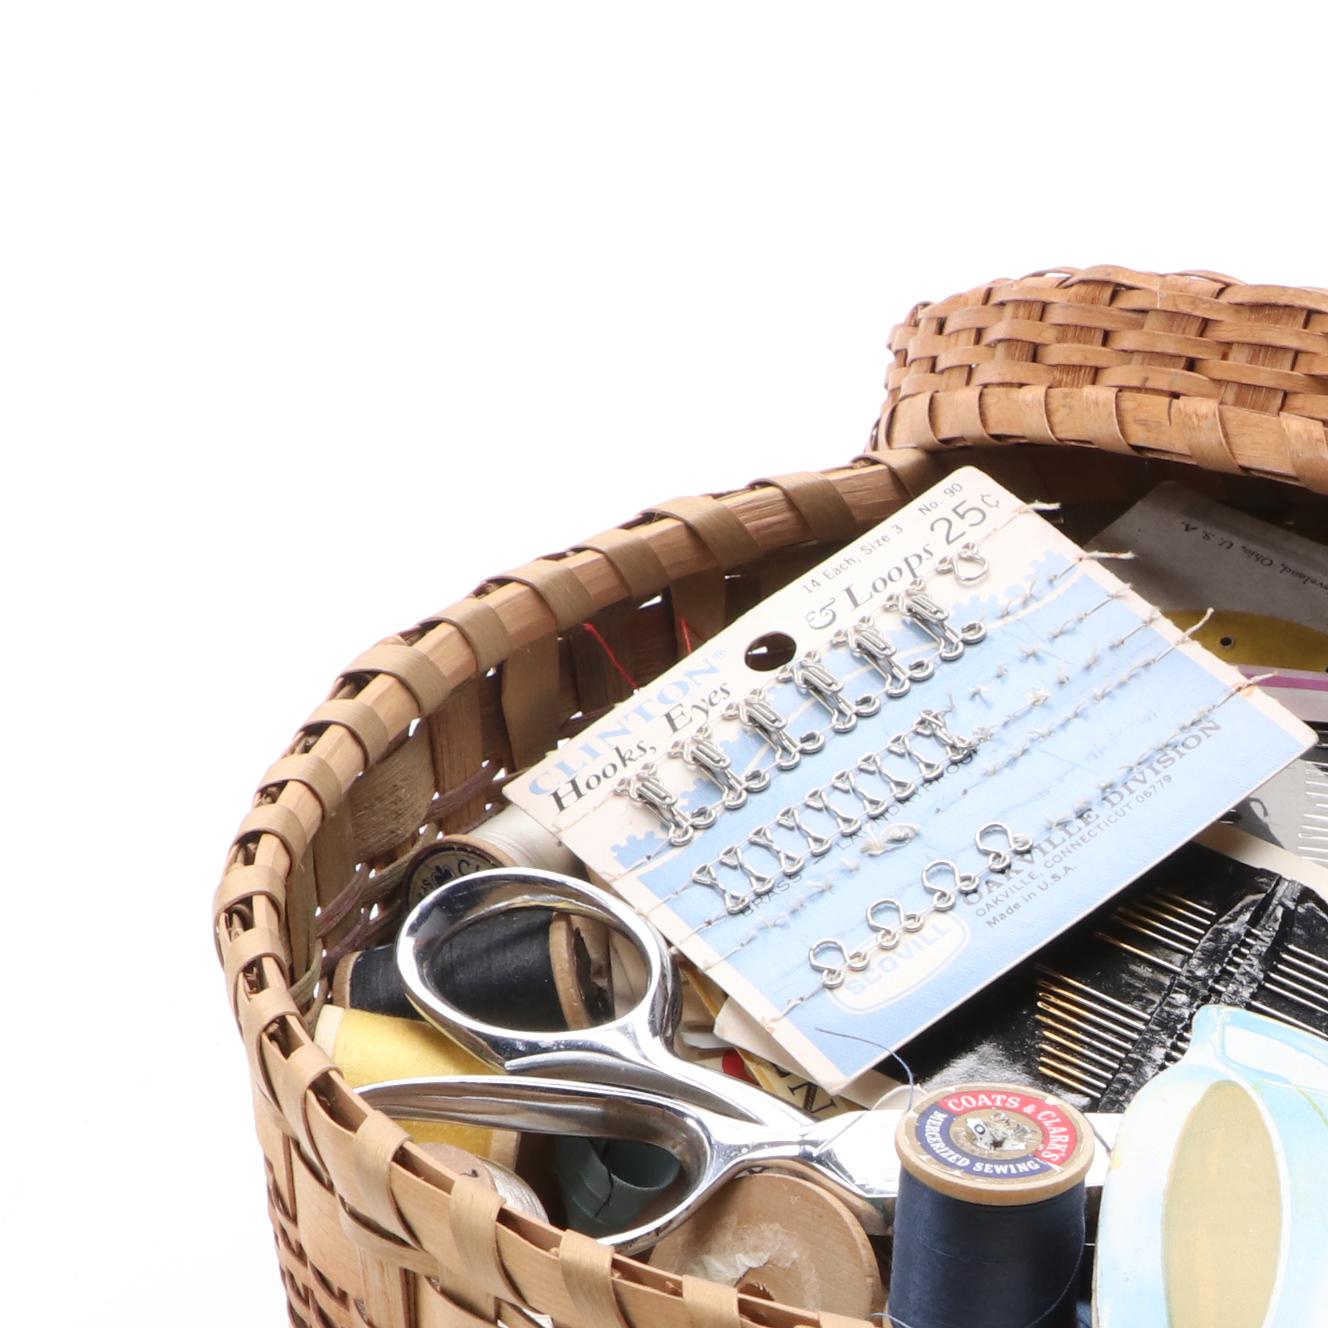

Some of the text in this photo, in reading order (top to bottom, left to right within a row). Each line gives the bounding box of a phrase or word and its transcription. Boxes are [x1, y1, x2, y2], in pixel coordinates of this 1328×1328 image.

[918, 482, 963, 516] No. 90
[802, 523, 904, 594] 14 Each, Size 3
[1241, 544, 1274, 568] Ohio,
[548, 543, 935, 813] Hooks, Eyes & Loops
[1101, 719, 1222, 810] DIVISION
[974, 774, 1173, 918] OAKVILLE, CONNECTICUT 06779
[985, 864, 1077, 929] Made in U.S.A.
[846, 923, 953, 997] SCOVILL
[924, 1110, 1041, 1175] MERCERIZED SEWING
[946, 1093, 1070, 1162] COATS & CLARK'S
